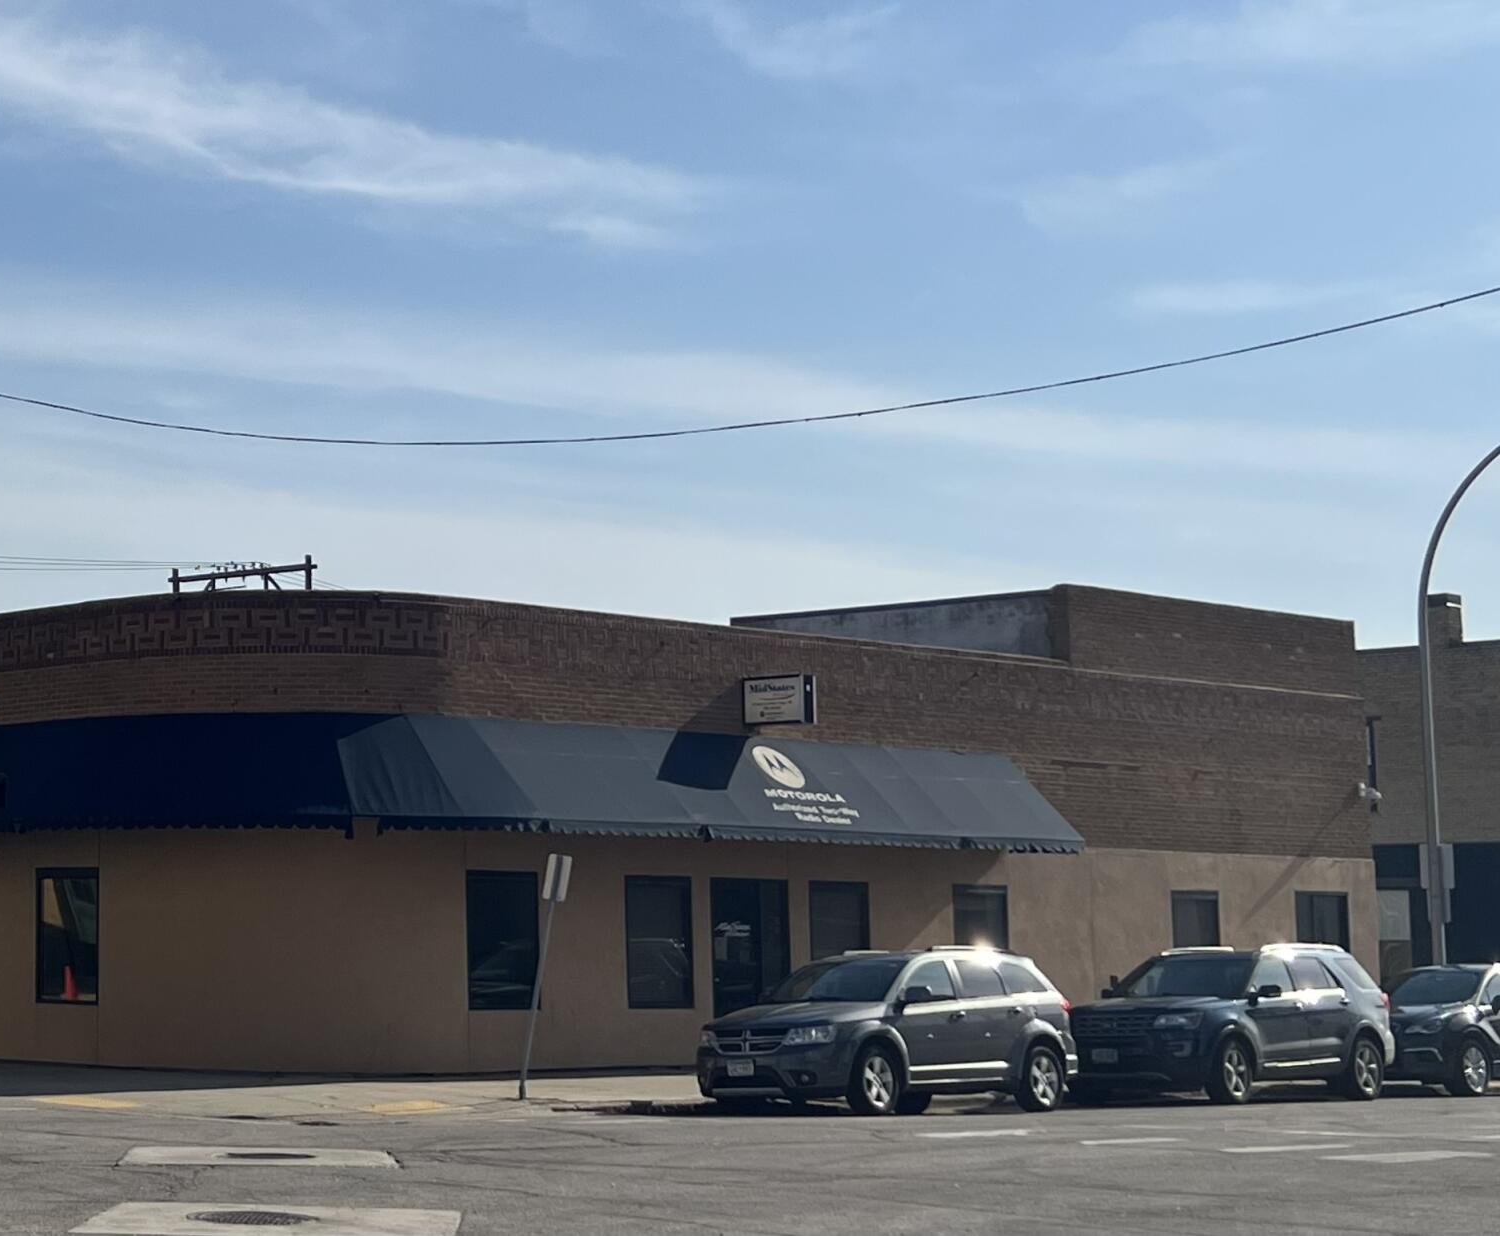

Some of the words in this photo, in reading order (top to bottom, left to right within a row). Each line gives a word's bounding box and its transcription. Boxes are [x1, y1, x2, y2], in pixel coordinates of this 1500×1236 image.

[763, 788, 847, 803] MOTOROLA
[771, 802, 819, 814] Authorized
[794, 811, 822, 823] Radio
